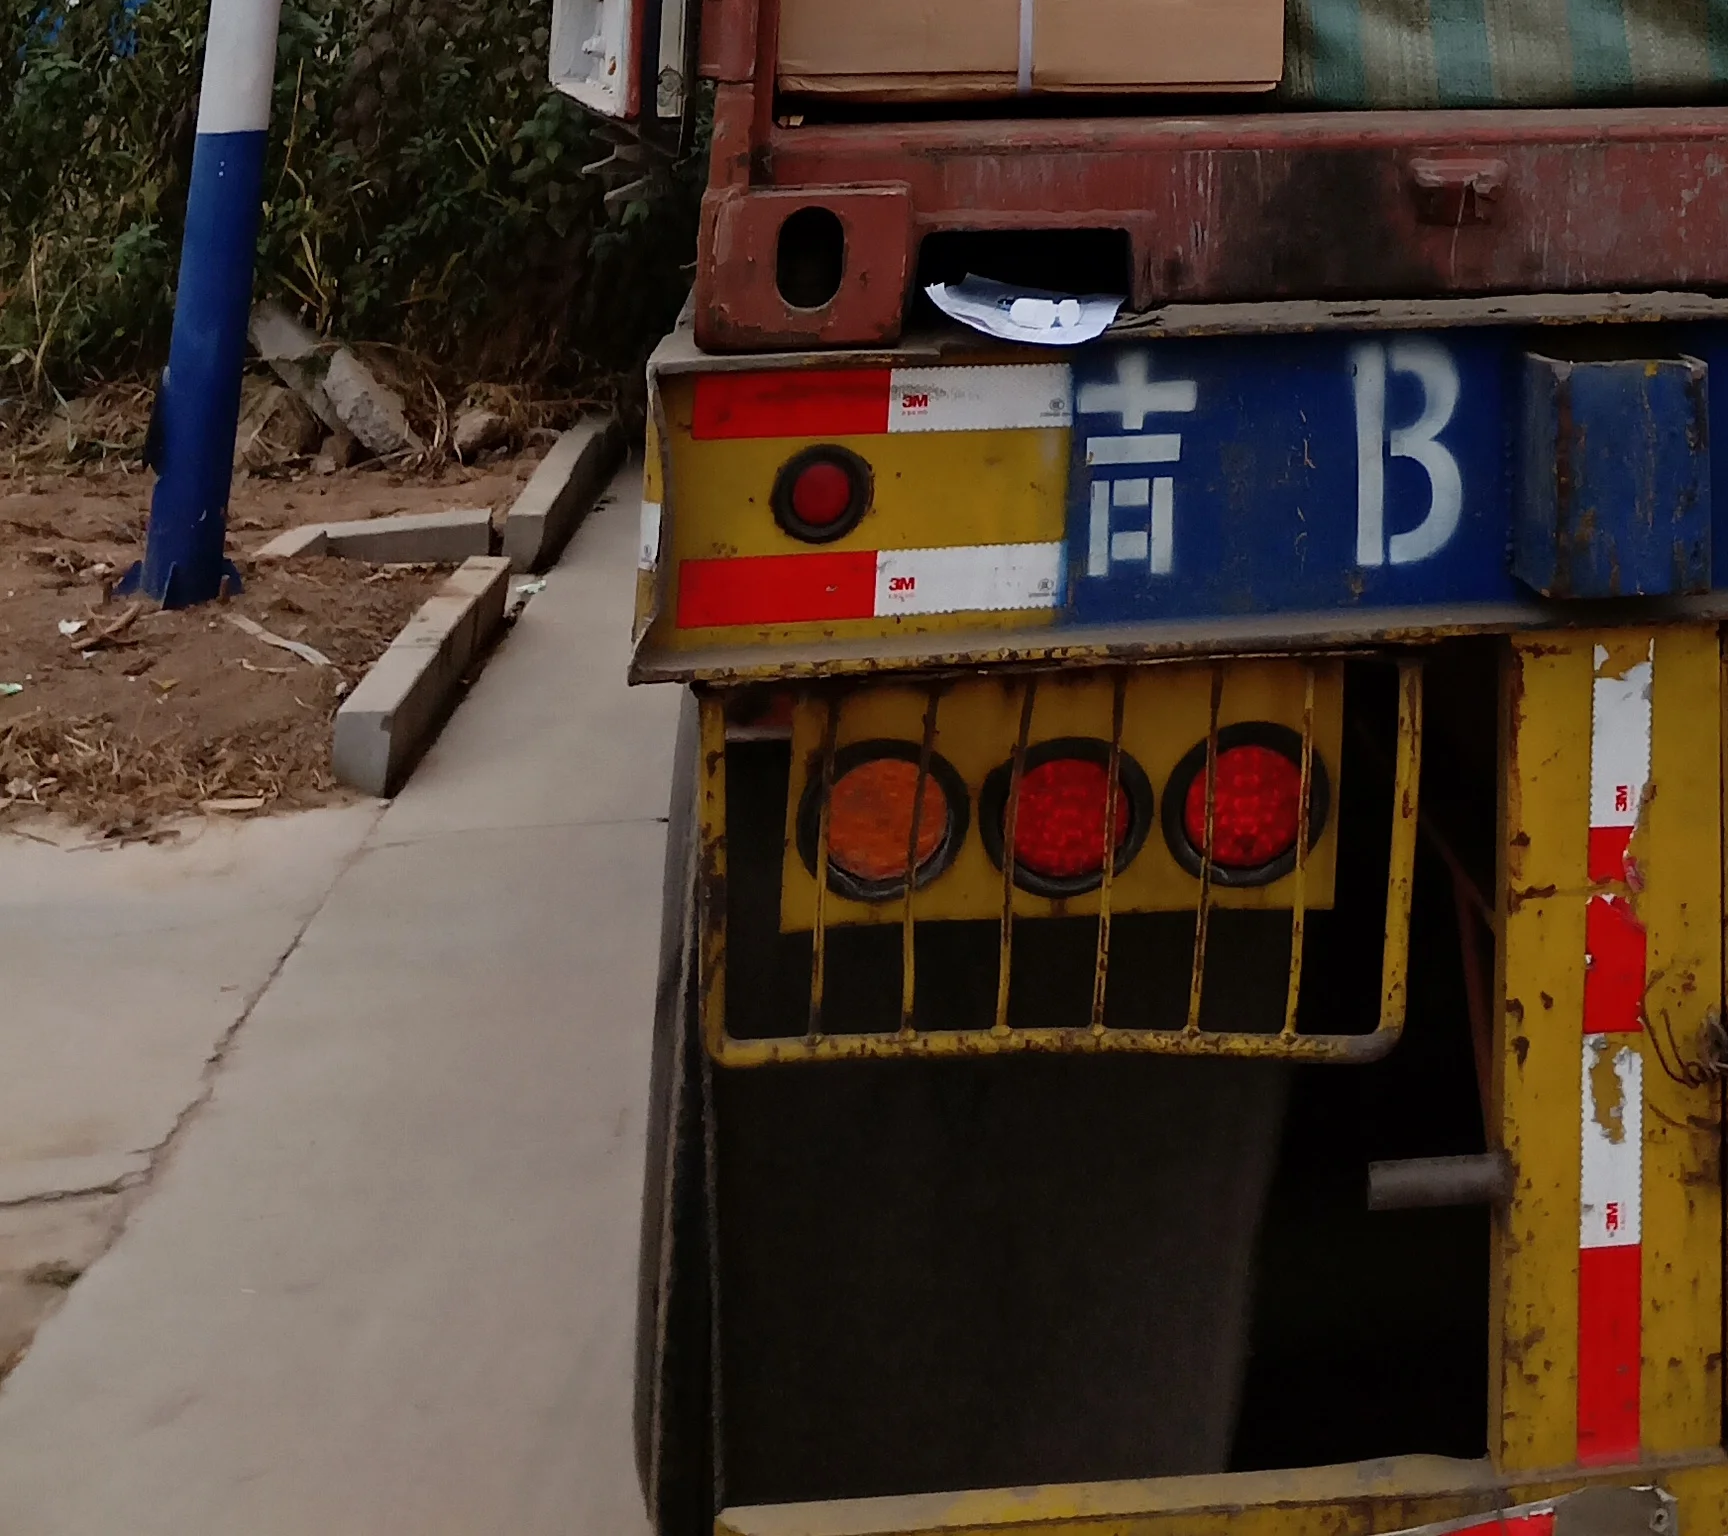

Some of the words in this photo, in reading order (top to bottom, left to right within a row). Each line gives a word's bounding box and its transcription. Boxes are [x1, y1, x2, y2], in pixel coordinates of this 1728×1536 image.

[902, 394, 928, 408] 3M
[1354, 337, 1463, 567] B
[889, 577, 915, 591] 3M
[1616, 785, 1628, 811] 3M
[1606, 1202, 1618, 1230] 3M
